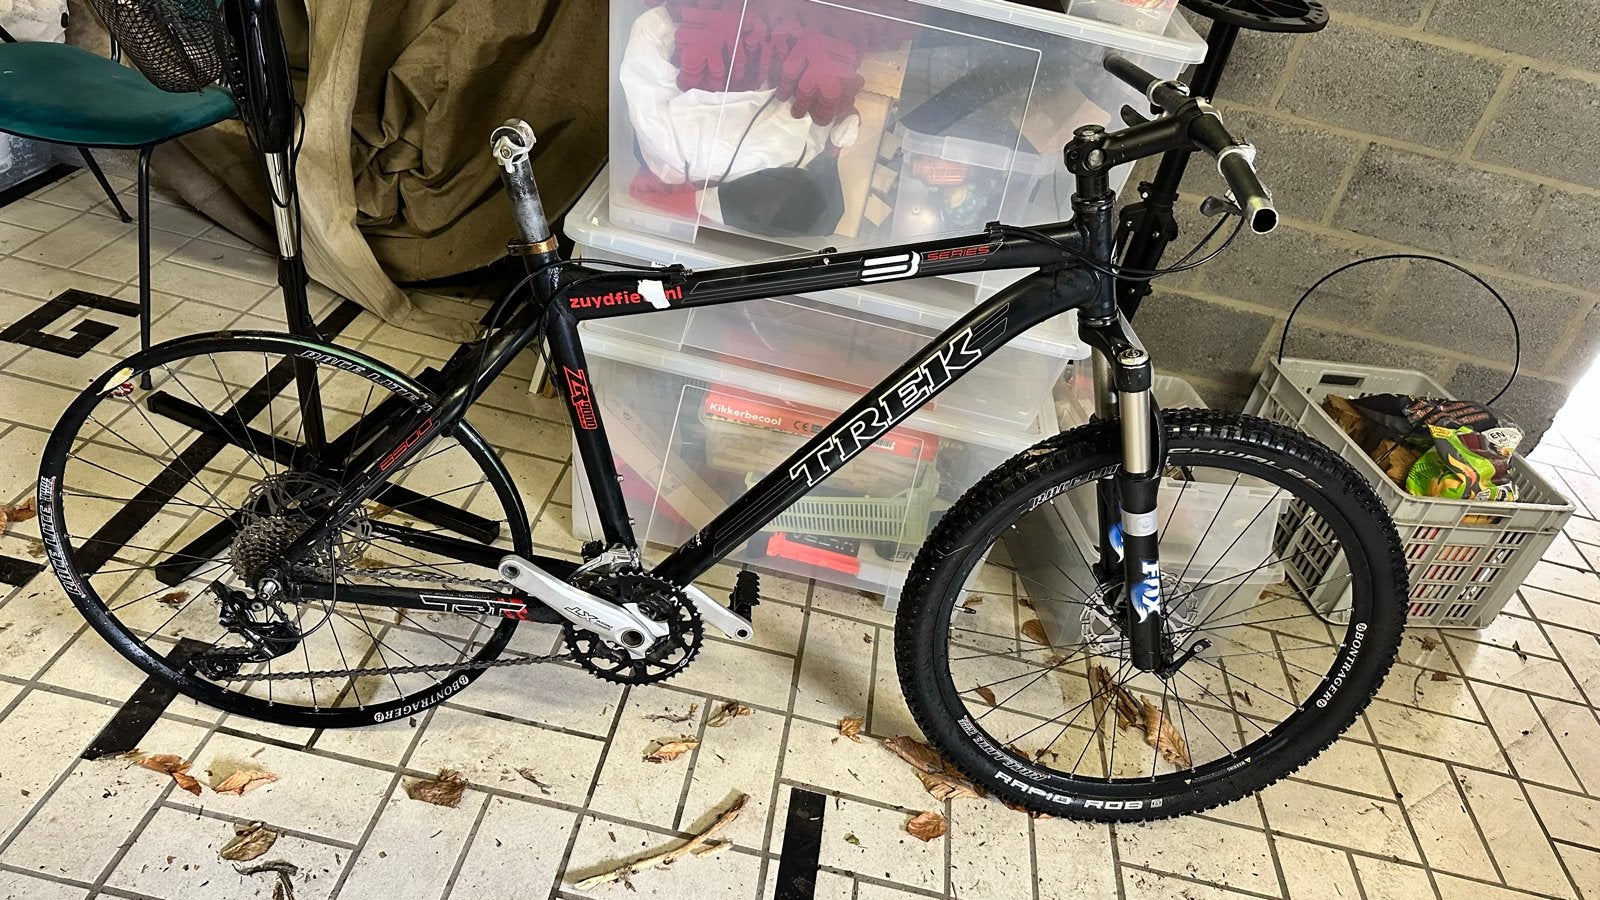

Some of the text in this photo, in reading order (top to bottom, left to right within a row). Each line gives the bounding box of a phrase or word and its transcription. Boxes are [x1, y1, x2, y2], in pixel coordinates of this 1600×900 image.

[927, 245, 990, 261] SERIES
[569, 285, 683, 309] zuydfienl
[709, 402, 782, 426] Kikkerbecool
[789, 327, 982, 487] TREK
[1140, 560, 1160, 616] FOX
[1323, 631, 1365, 701] BONTRAGER
[385, 682, 460, 720] BONTRAGER
[994, 770, 1144, 810] RAPID ROB
